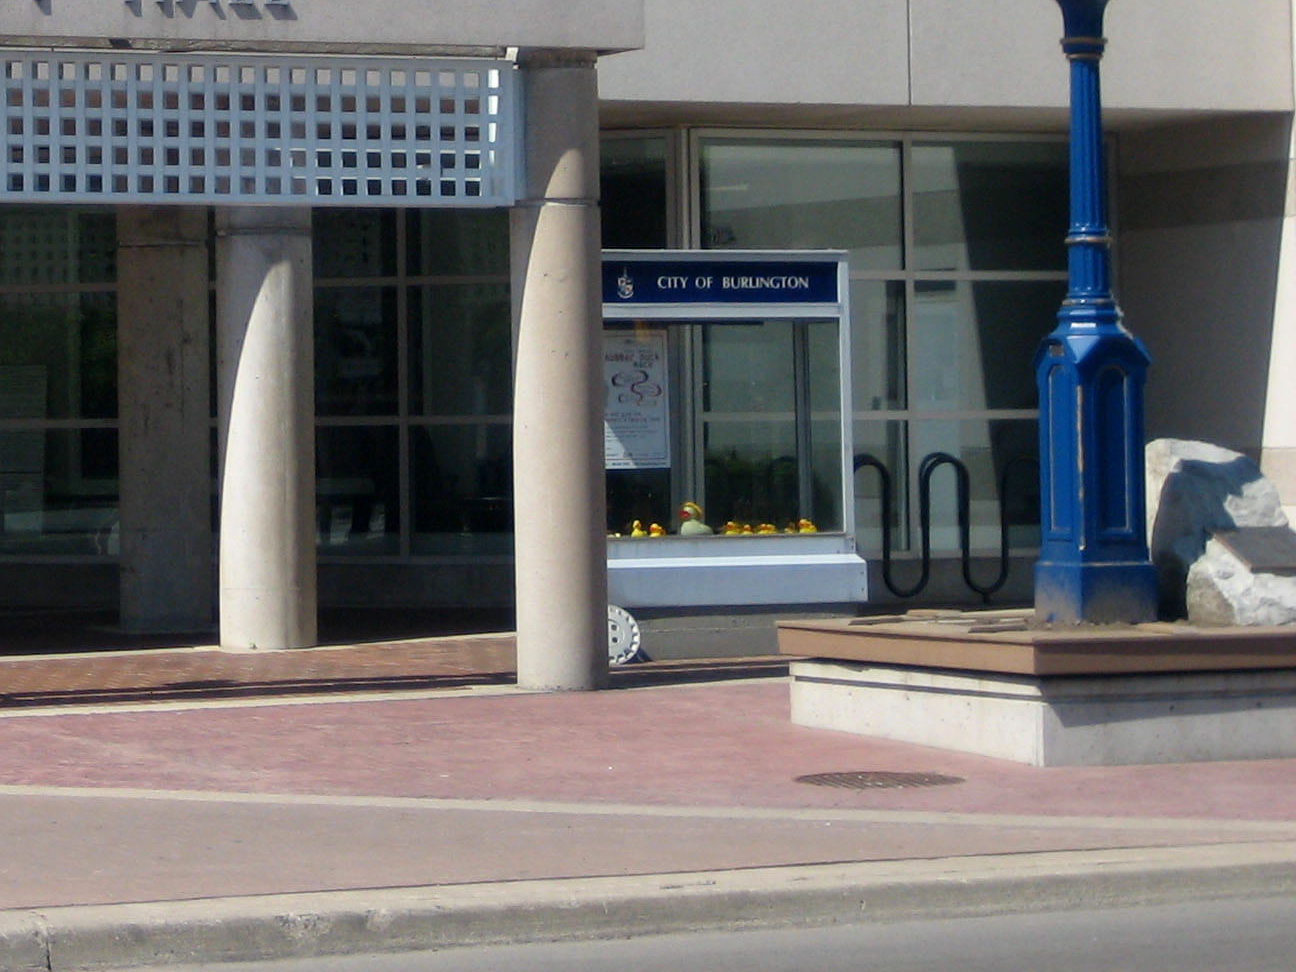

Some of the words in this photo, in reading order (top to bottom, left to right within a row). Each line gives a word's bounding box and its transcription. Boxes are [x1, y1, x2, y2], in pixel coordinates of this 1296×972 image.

[656, 275, 688, 290] CITY
[695, 276, 714, 290] OF
[722, 275, 810, 290] BURLINGTON
